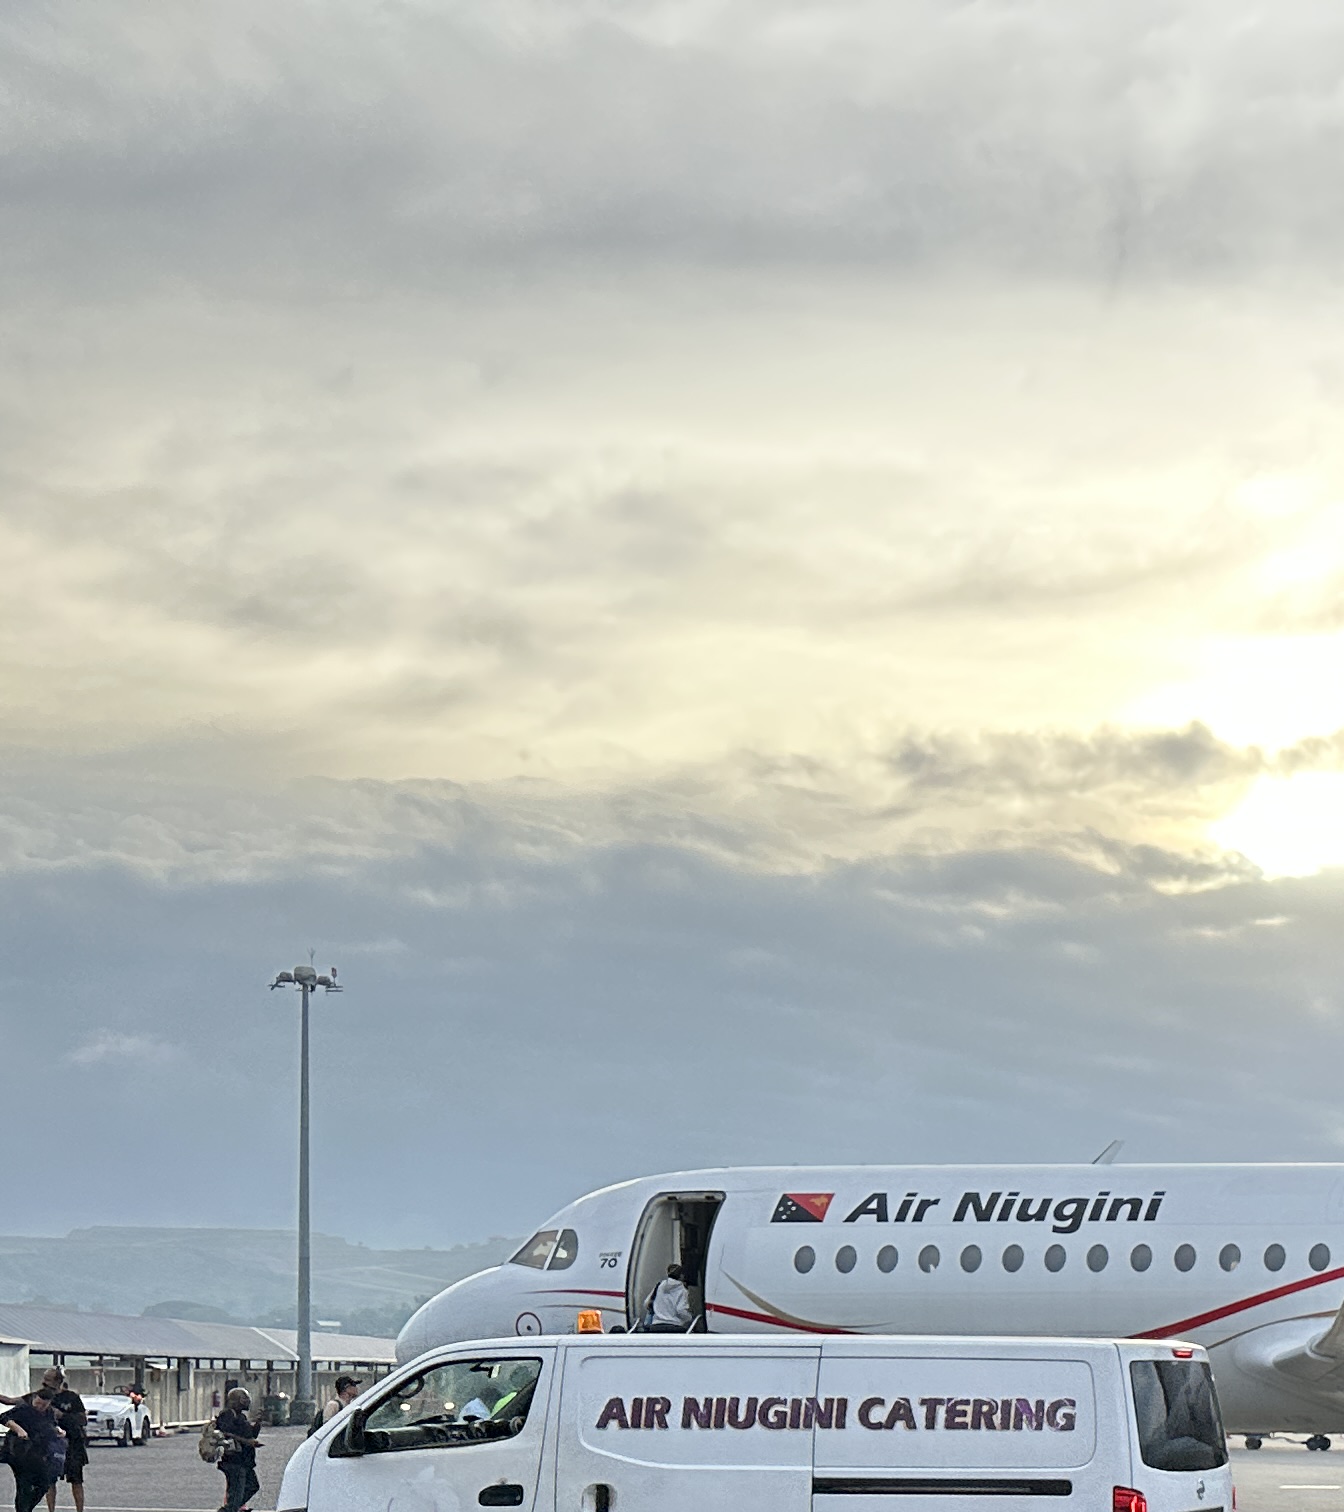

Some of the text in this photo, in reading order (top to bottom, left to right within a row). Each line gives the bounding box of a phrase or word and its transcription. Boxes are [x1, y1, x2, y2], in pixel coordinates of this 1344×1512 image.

[842, 1191, 1166, 1233] Air Niugini
[600, 1257, 618, 1268] 70
[595, 1396, 1077, 1431] AIR NIUGINI CATERING
